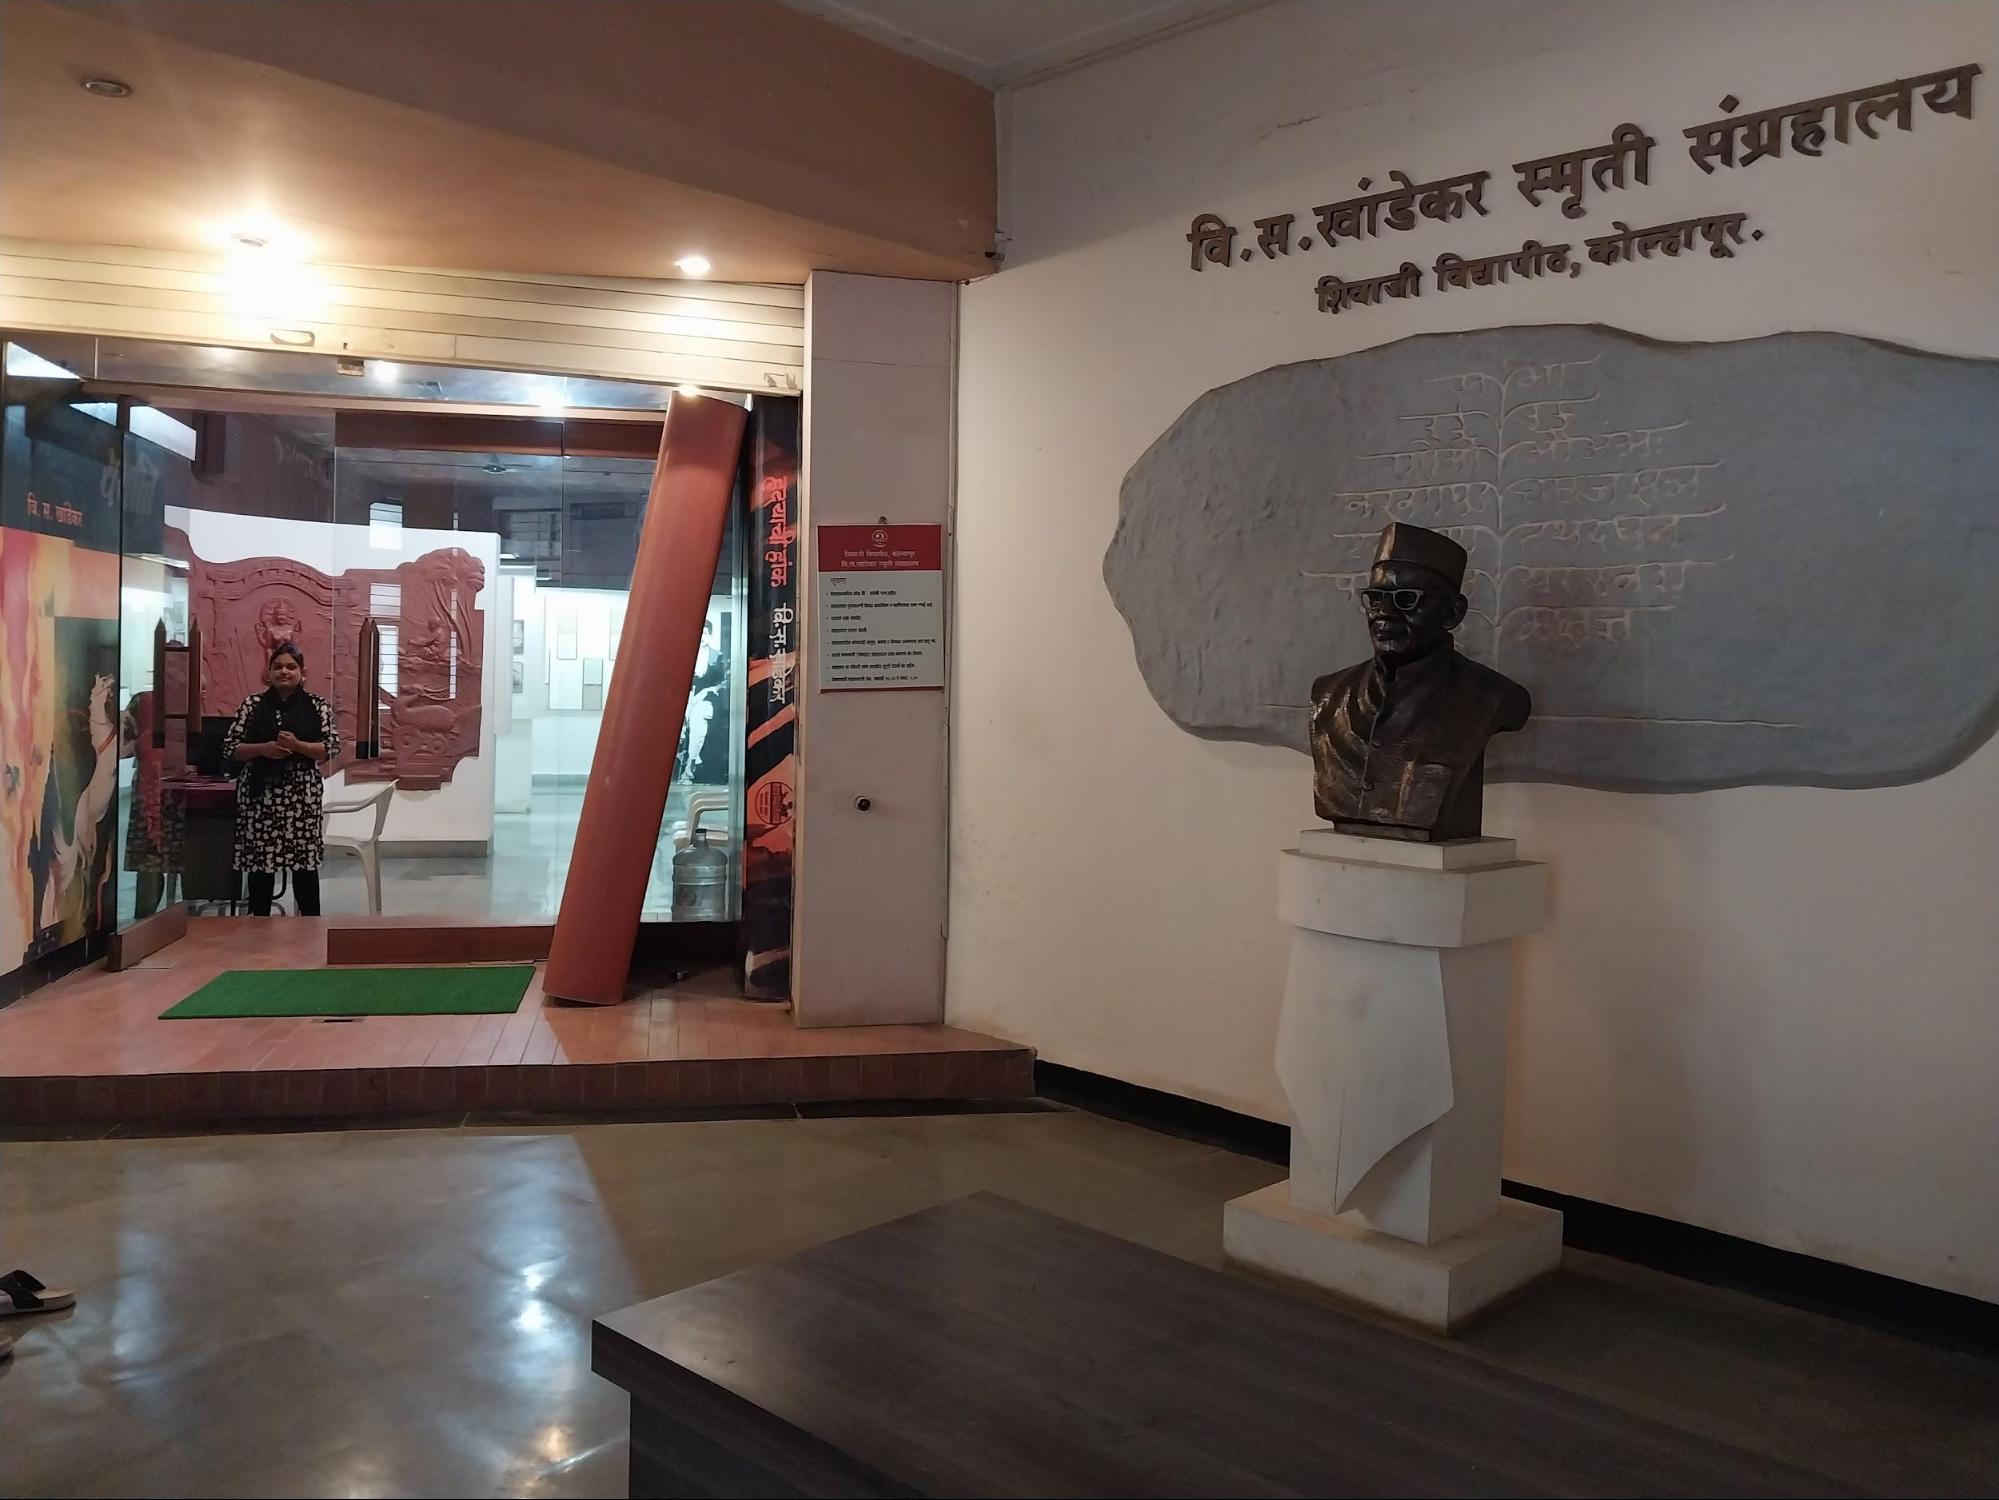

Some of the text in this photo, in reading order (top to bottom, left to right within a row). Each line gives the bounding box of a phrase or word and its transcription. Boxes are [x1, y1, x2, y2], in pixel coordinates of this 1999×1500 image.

[1512, 122, 1656, 220] स्मृती
[1682, 63, 1983, 175] संग्रहालय
[1314, 261, 1423, 314] शिवाजी
